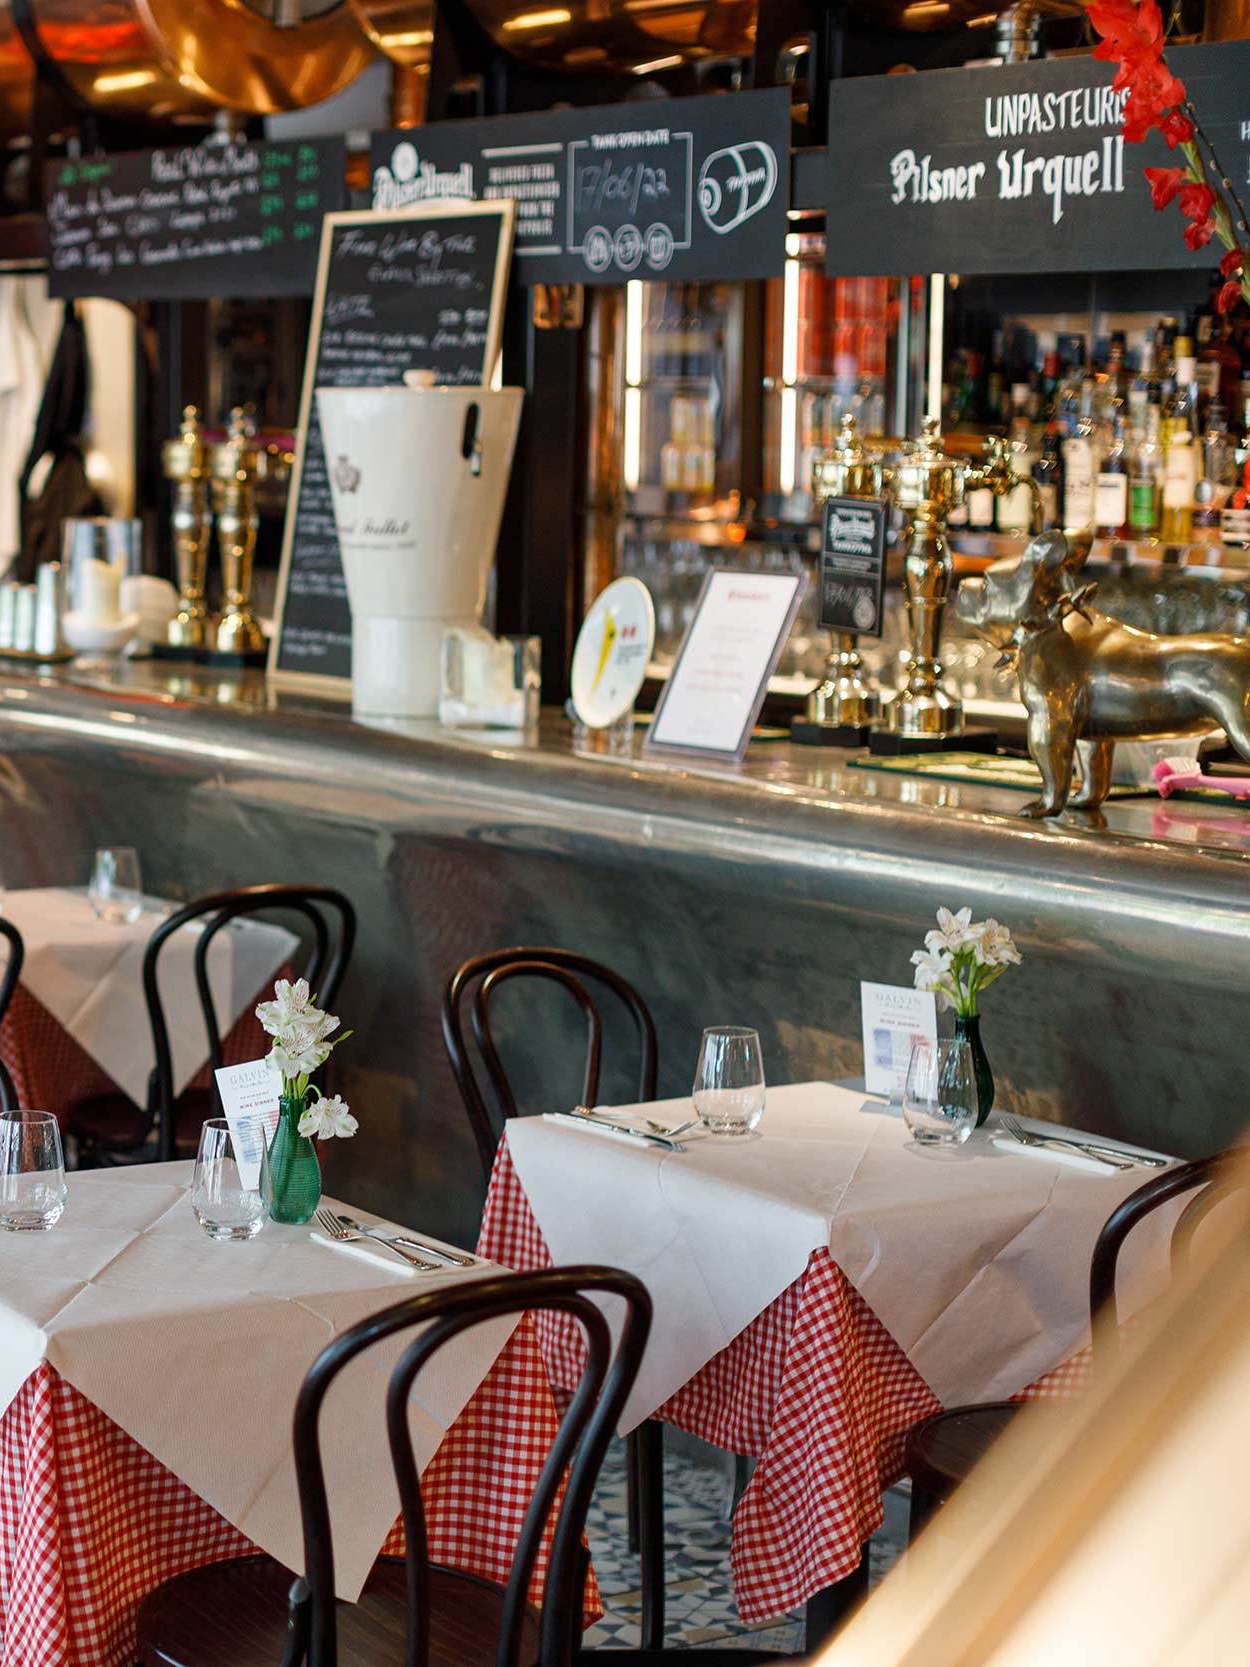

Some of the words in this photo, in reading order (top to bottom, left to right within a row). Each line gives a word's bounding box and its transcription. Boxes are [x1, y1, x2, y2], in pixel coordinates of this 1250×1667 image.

[890, 149, 986, 205] Pilsner
[997, 134, 1125, 225] Urquell
[230, 1069, 269, 1085] GALVIN
